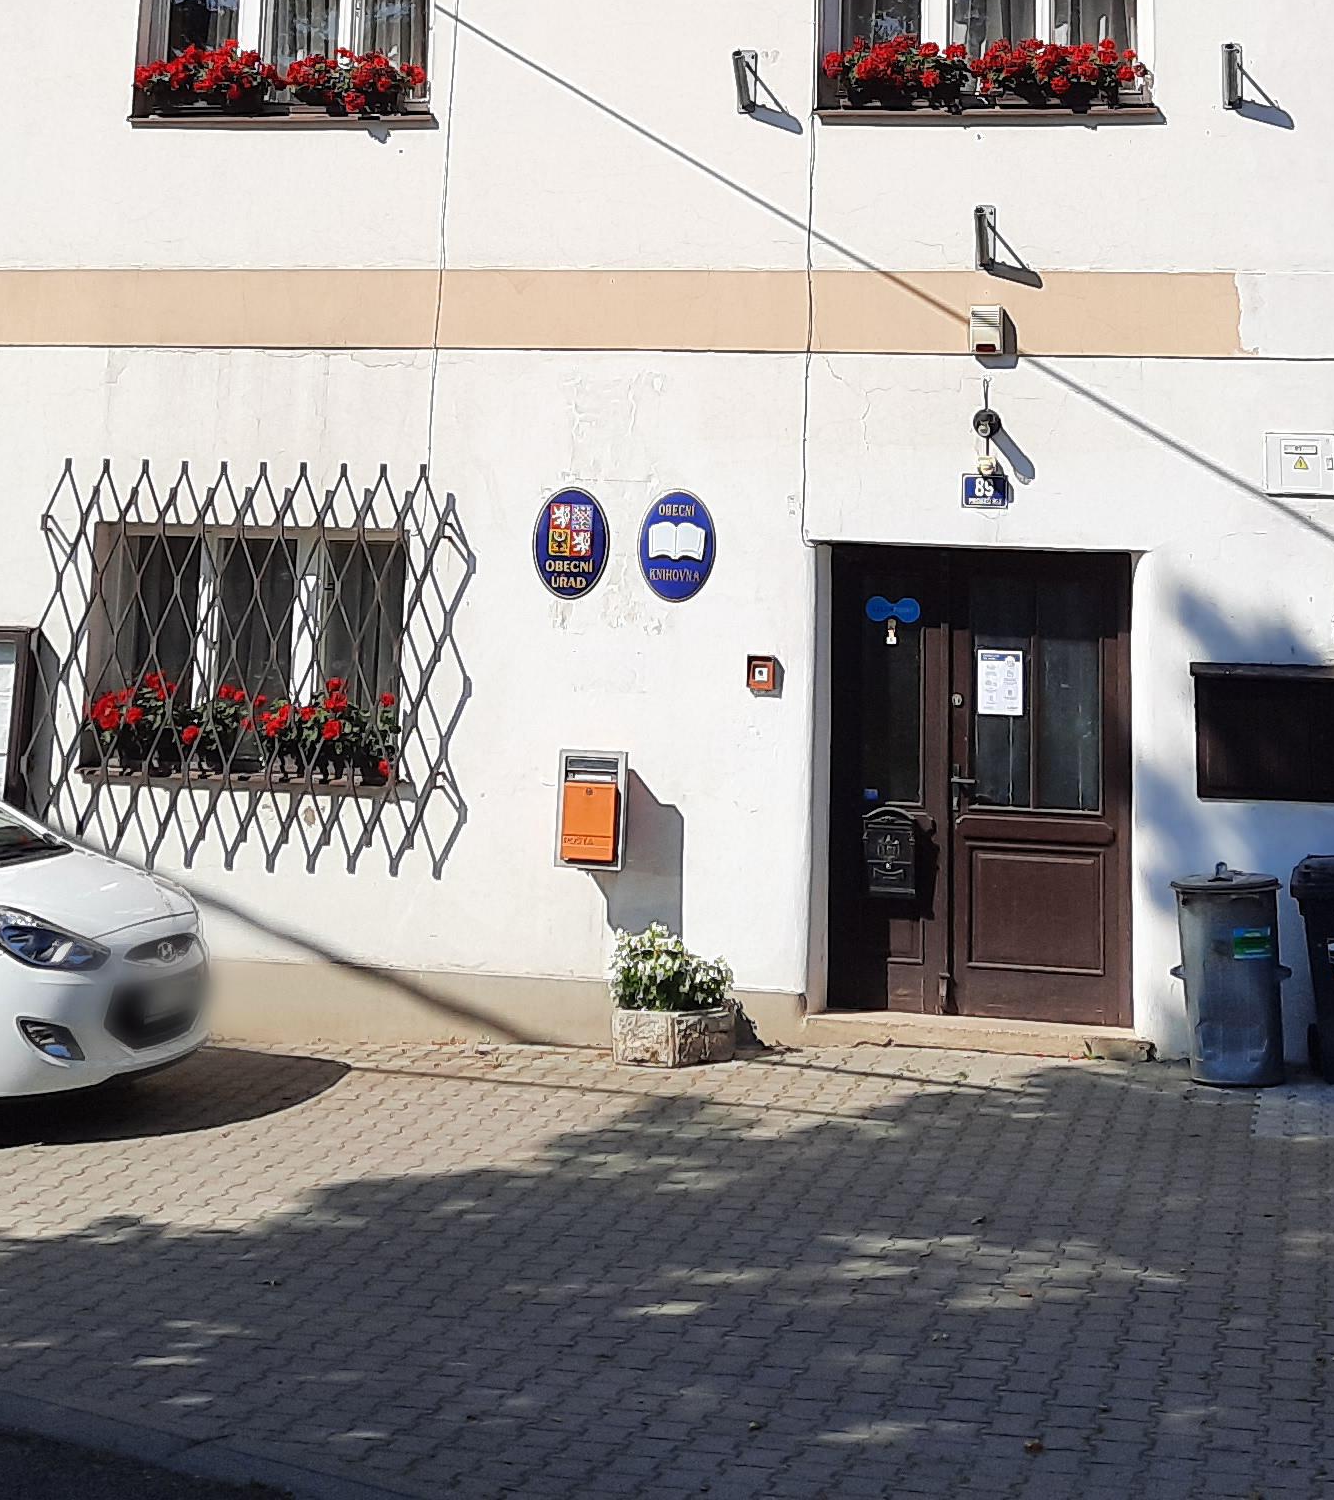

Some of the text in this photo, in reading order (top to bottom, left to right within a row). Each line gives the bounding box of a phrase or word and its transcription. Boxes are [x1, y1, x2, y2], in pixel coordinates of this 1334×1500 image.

[658, 503, 695, 516] OBECNÍ
[546, 559, 593, 573] OBECNÍ
[551, 573, 586, 588] ÚŘAD
[649, 568, 700, 582] KNIHOVNA
